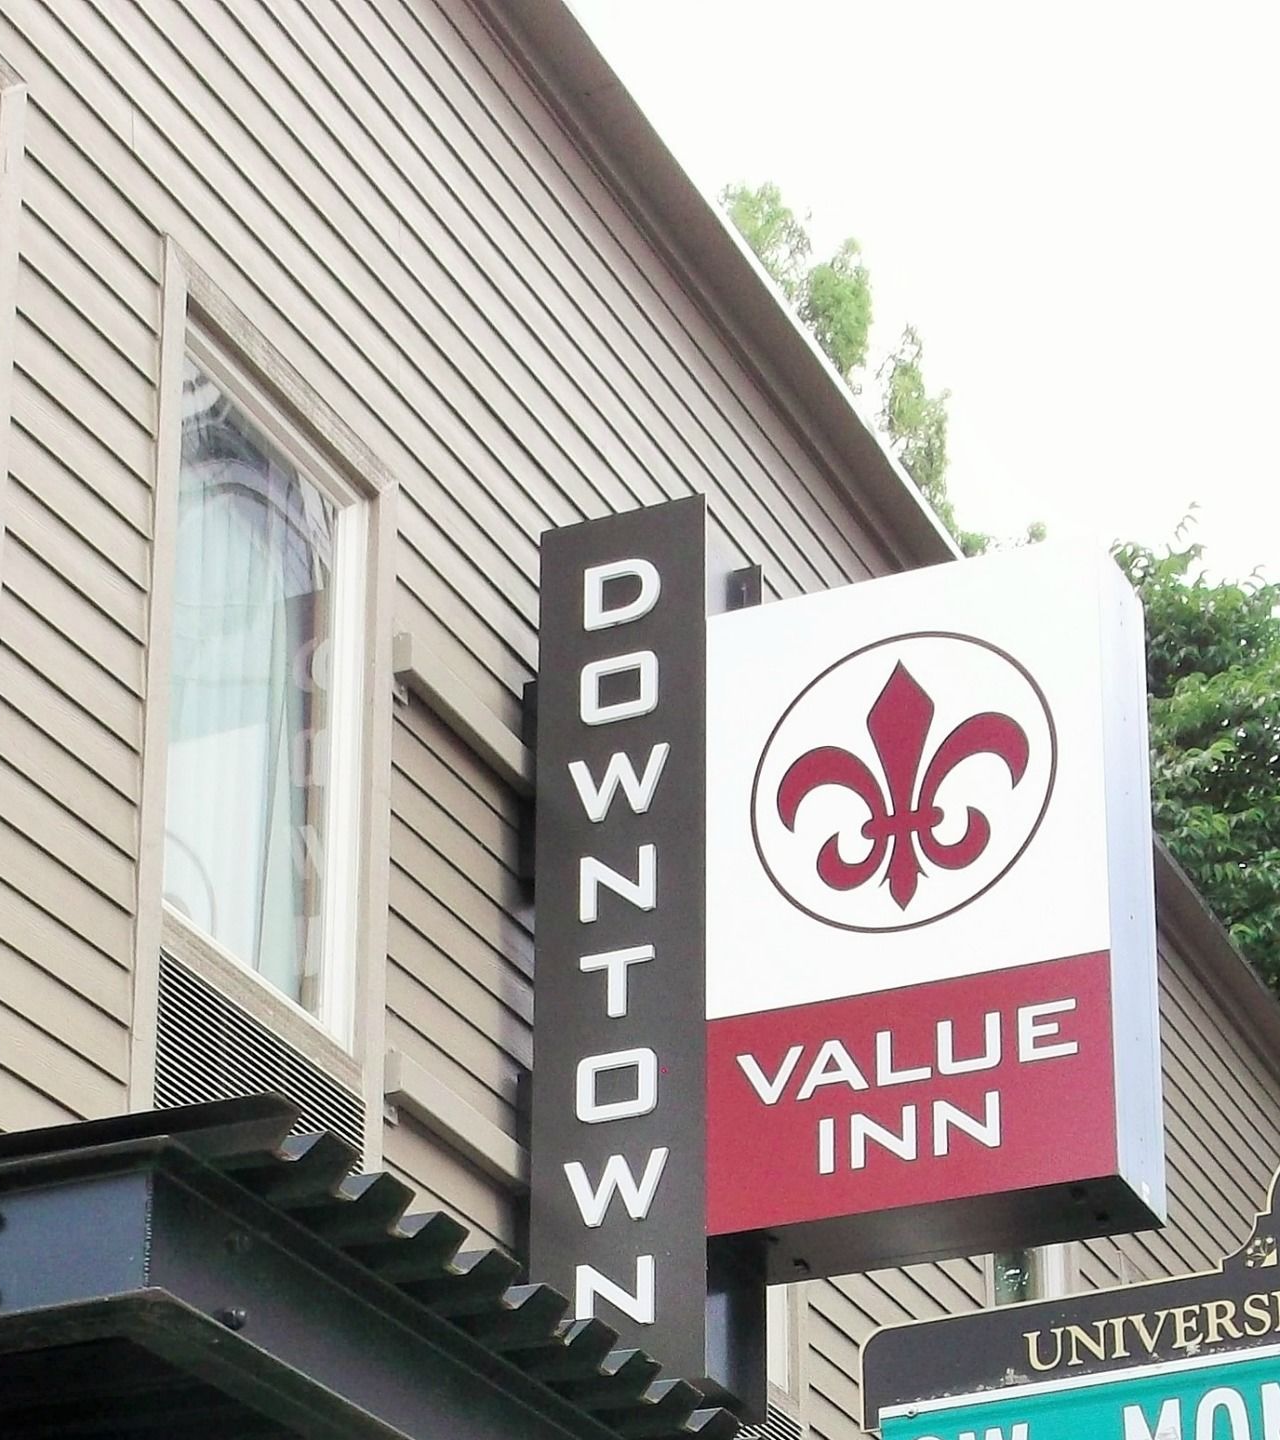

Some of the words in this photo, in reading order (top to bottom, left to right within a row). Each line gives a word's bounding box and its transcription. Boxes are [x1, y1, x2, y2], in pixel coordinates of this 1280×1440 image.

[563, 558, 672, 1325] DOWNTOWN
[736, 998, 1080, 1106] VALUE
[818, 1090, 1003, 1176] INN
